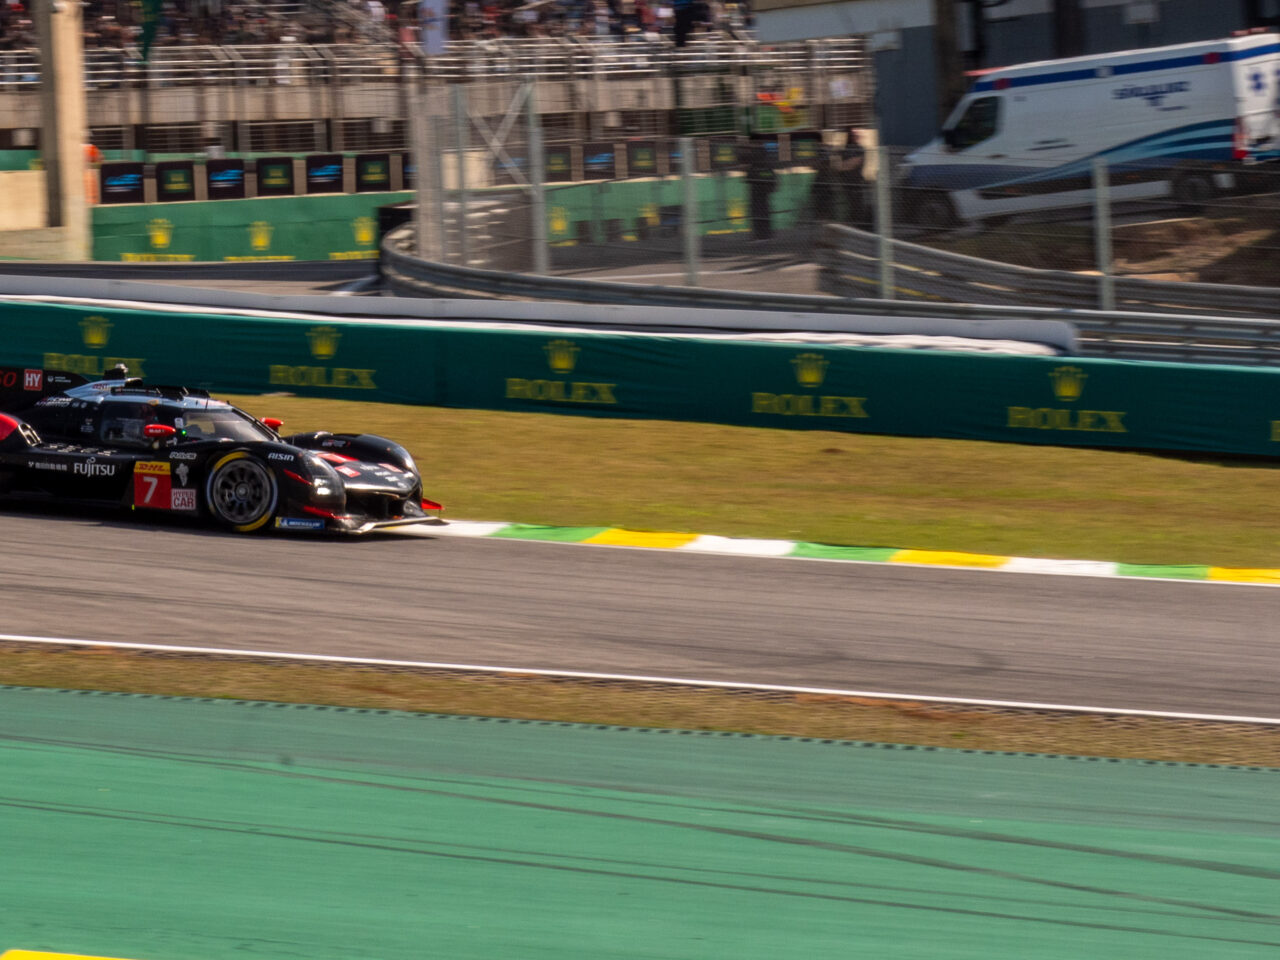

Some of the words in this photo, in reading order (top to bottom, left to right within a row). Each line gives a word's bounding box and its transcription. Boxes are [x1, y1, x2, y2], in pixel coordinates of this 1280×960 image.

[25, 372, 41, 387] HY
[269, 364, 377, 389] ROLEX
[505, 377, 618, 405] ROLEX
[751, 391, 869, 419] ROLEX
[1007, 406, 1128, 433] ROLEX
[74, 460, 115, 477] FUJITSU
[139, 463, 164, 471] DHL
[143, 476, 158, 503] 7
[174, 497, 195, 508] CAR
